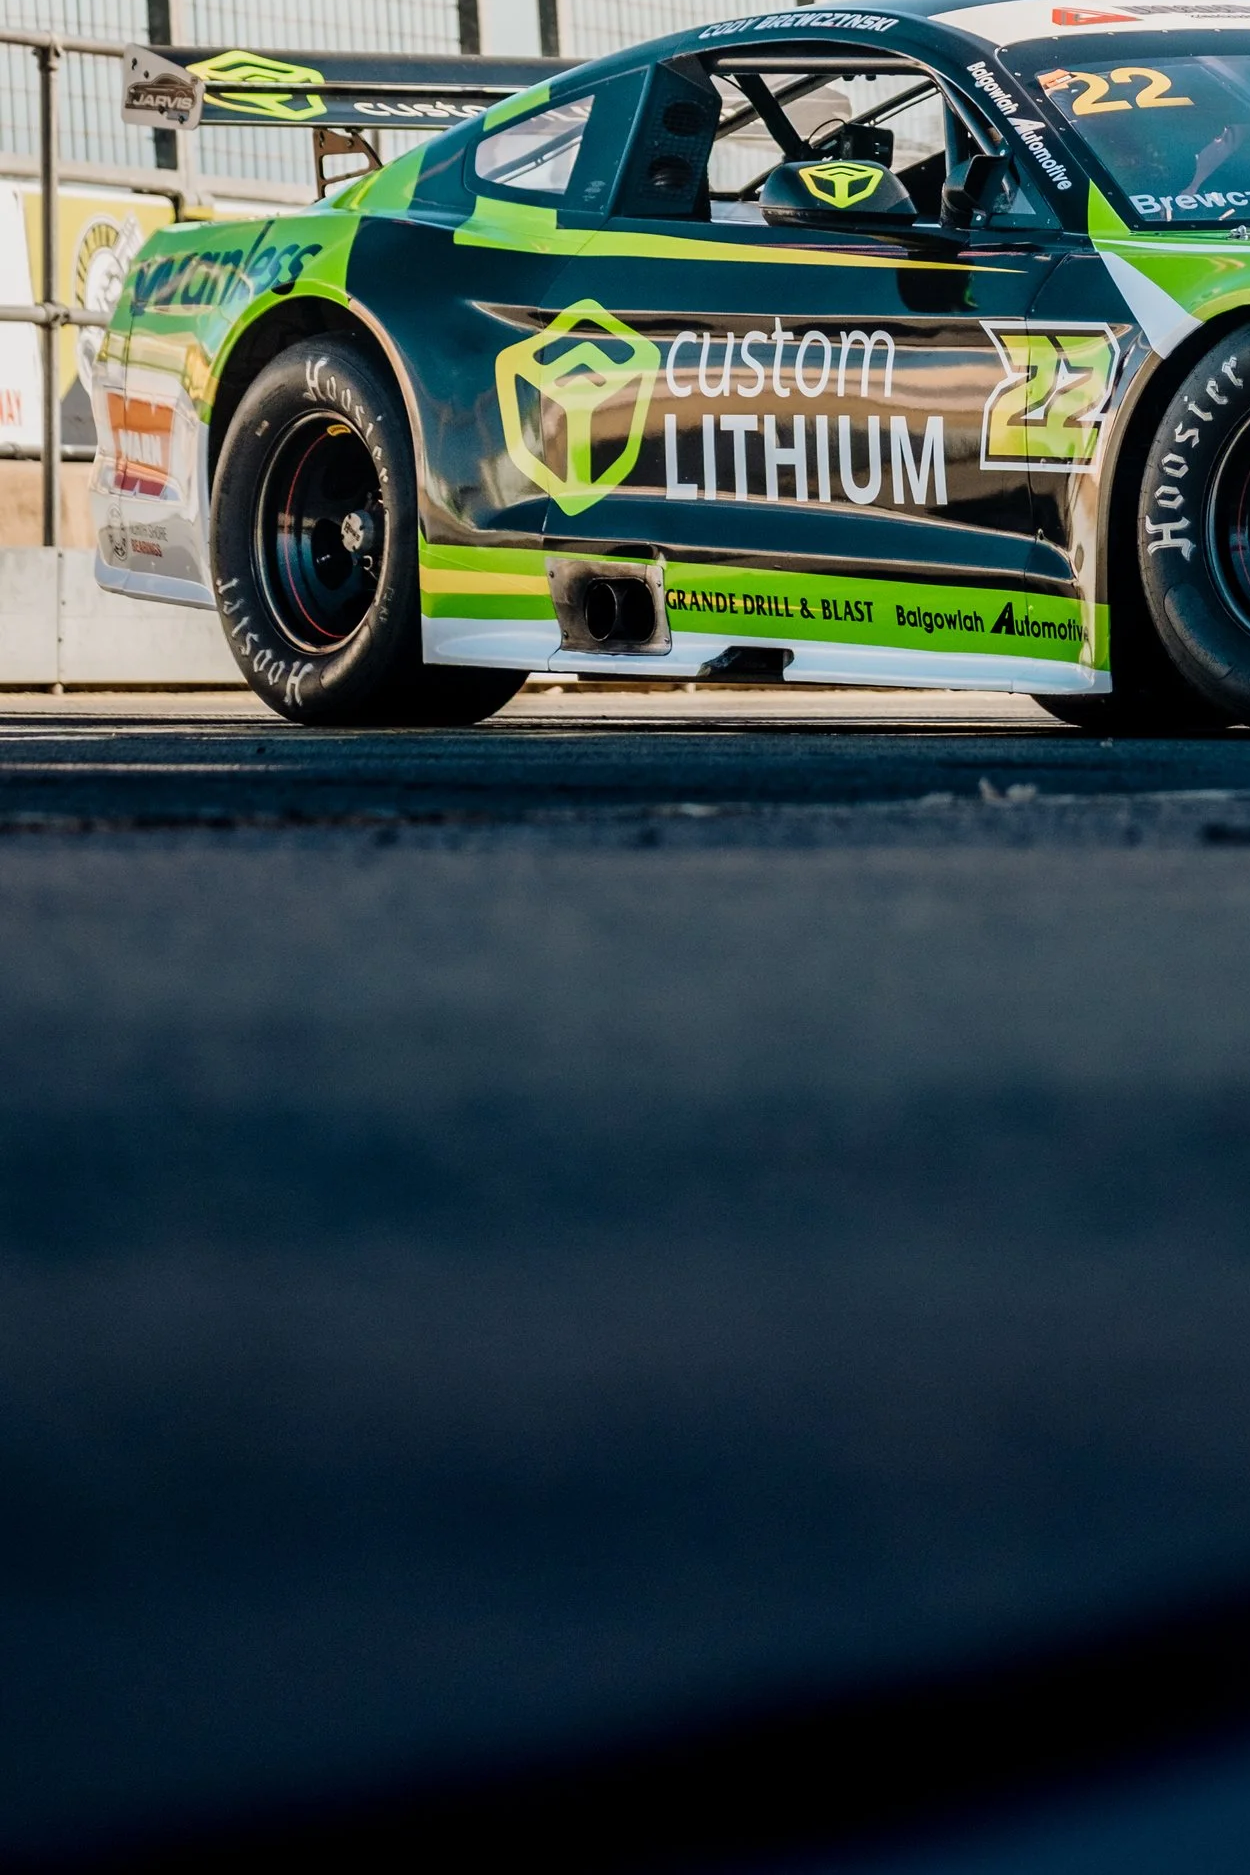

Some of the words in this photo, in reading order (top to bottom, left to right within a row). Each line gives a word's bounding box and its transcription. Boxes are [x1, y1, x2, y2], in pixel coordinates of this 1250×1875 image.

[699, 17, 754, 39] CODY
[753, 11, 899, 32] BREWCZYNSKI
[132, 93, 193, 110] JARVIS
[353, 100, 487, 118] custo
[1072, 67, 1195, 116] 22
[966, 61, 1019, 116] Balgowlah
[1007, 117, 1072, 190] Automotive
[665, 317, 896, 398] custom
[304, 356, 389, 484] Hoosier
[986, 331, 1114, 461] 22
[665, 414, 948, 506] LITHIUM
[1145, 356, 1244, 562] Hoosier
[666, 587, 736, 615] GRANDE
[742, 593, 794, 618] DRILL
[800, 597, 816, 620] &
[821, 598, 874, 624] BLAST
[896, 604, 985, 634] Balgowlah
